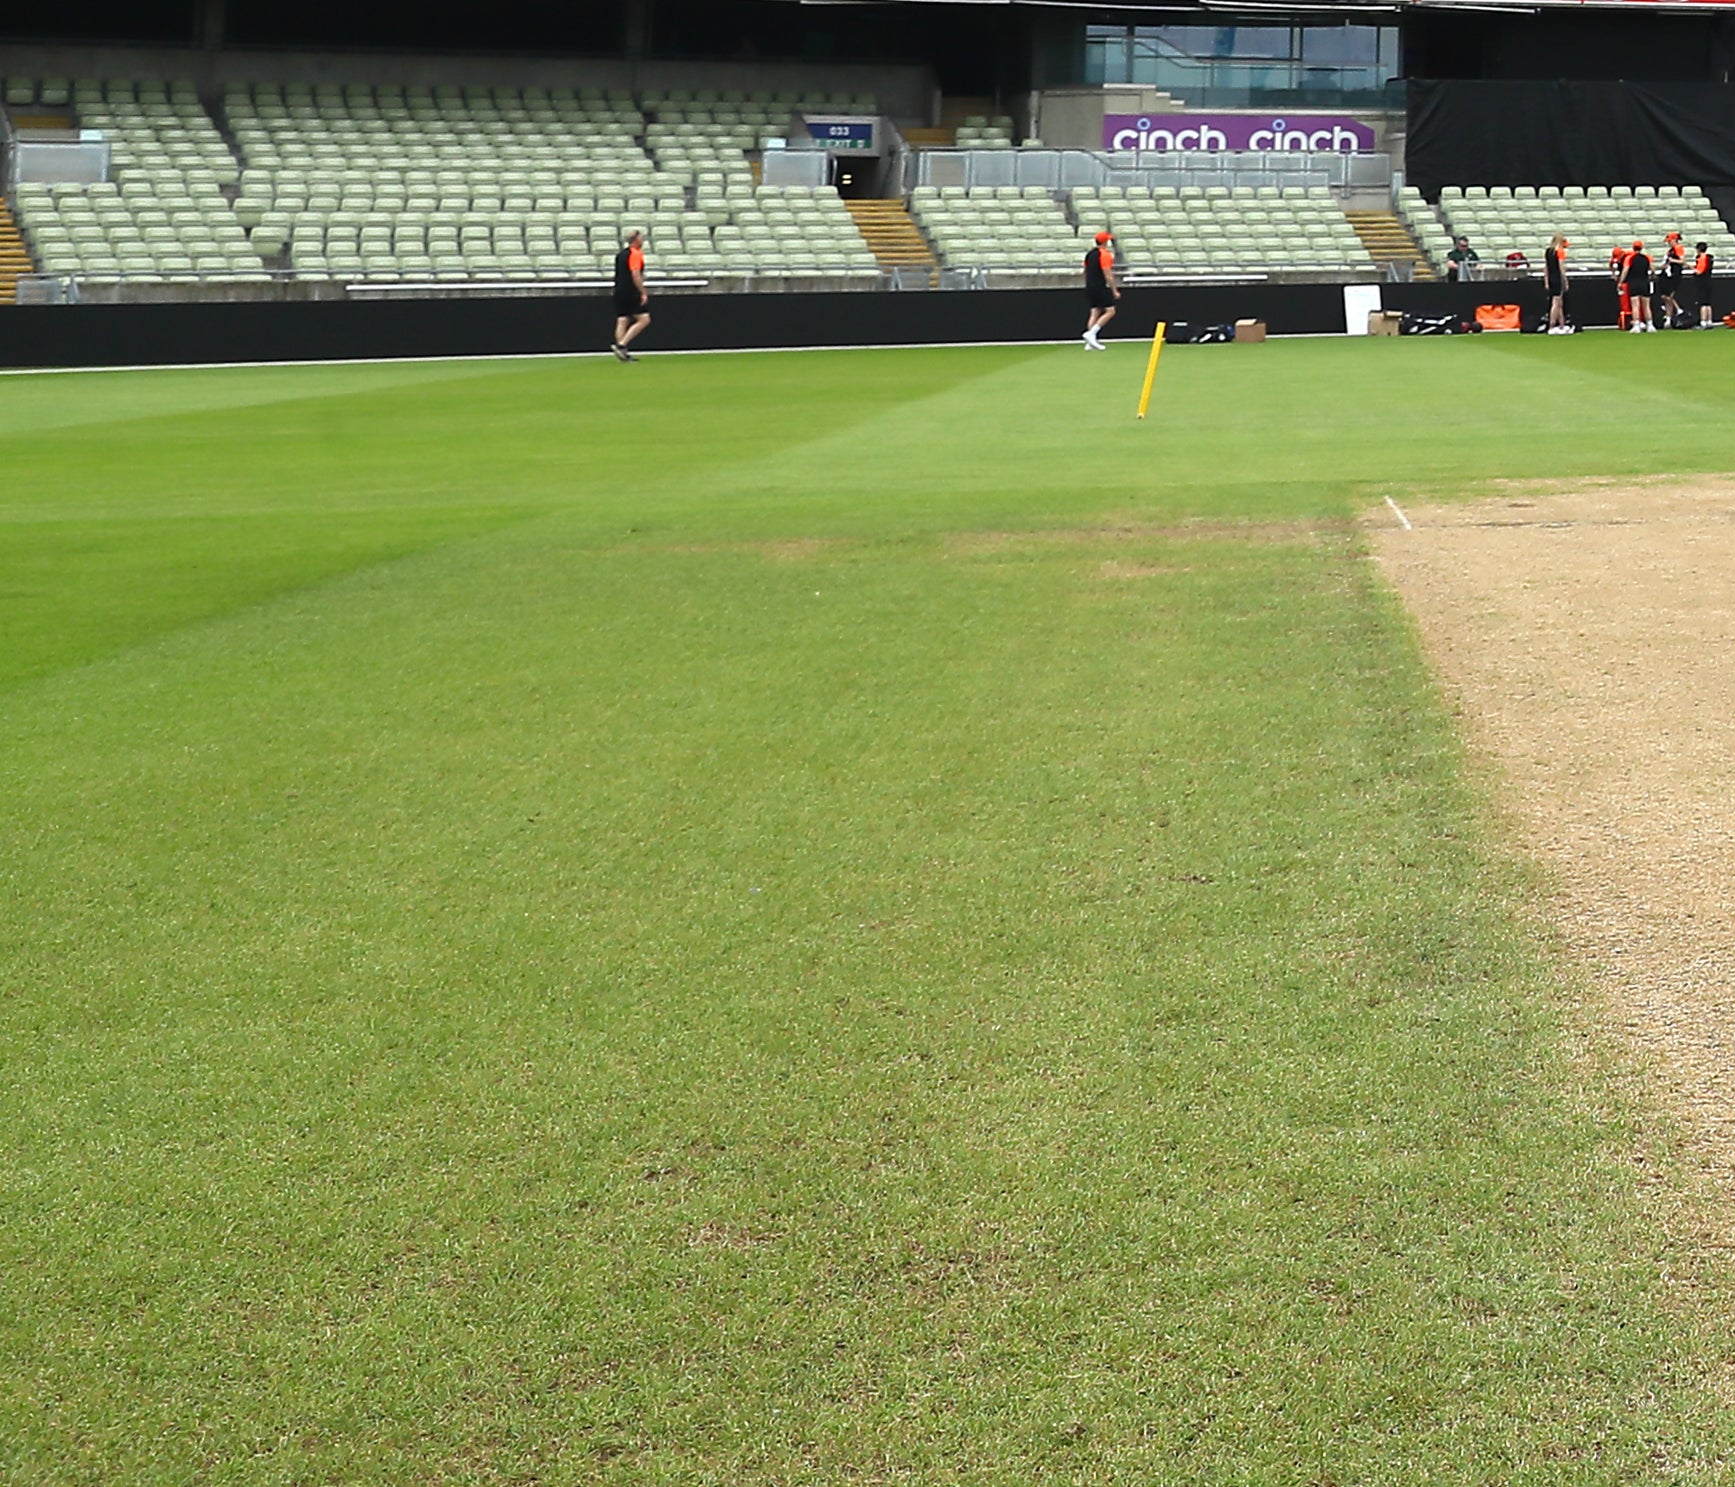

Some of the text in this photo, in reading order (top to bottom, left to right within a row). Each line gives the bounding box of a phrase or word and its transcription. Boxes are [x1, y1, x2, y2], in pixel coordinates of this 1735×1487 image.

[829, 126, 850, 136] 033
[1113, 117, 1227, 152] cinch
[1249, 117, 1359, 152] cinch
